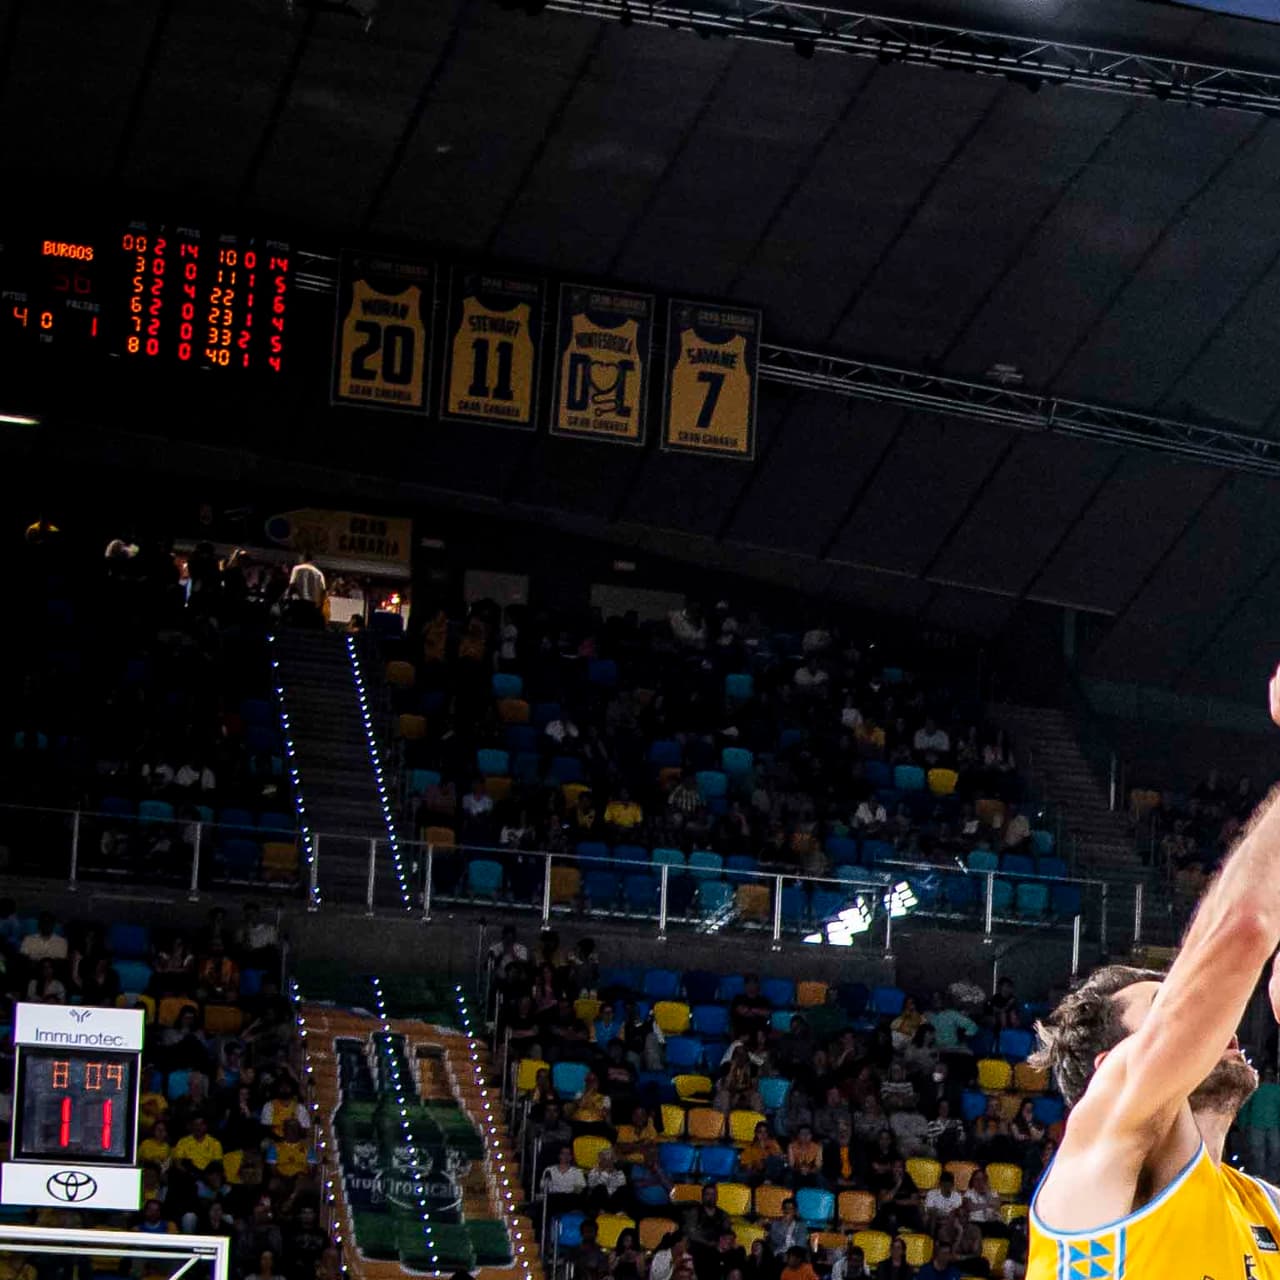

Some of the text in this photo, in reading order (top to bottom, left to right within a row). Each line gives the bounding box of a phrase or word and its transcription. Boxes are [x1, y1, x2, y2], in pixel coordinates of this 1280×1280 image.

[42, 240, 94, 261] BURGOS
[351, 320, 414, 384] 20
[470, 338, 513, 400] 11
[697, 372, 725, 428] 7
[35, 1027, 123, 1047] Immunotec
[52, 1061, 123, 1090] 8 09
[59, 1095, 113, 1151] 11
